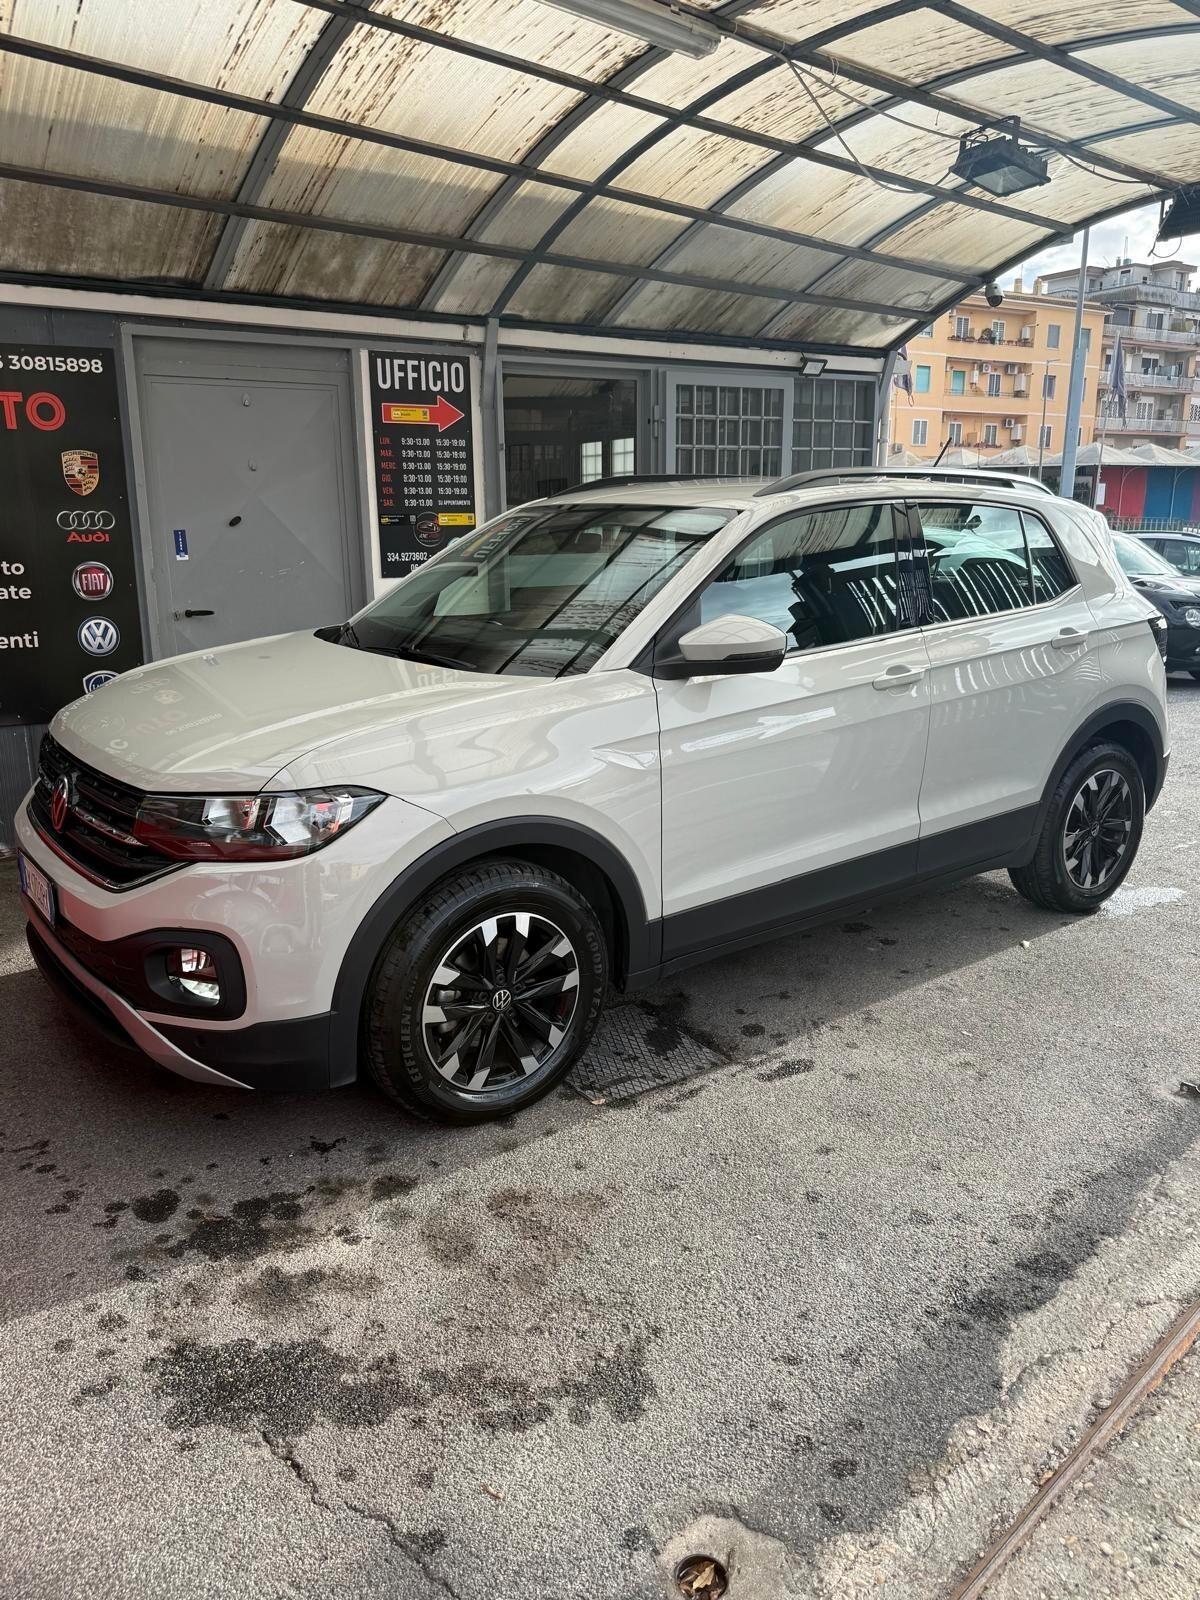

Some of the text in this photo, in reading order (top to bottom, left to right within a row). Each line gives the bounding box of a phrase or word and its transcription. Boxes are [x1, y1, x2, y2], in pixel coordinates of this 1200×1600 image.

[8, 355, 103, 373] 30815898
[376, 358, 465, 393] UFFICIO
[0, 391, 66, 431] TO
[67, 531, 110, 543] Audi
[1, 561, 25, 575] to
[81, 573, 105, 591] FIAT
[0, 585, 32, 600] ate
[0, 631, 39, 649] enti
